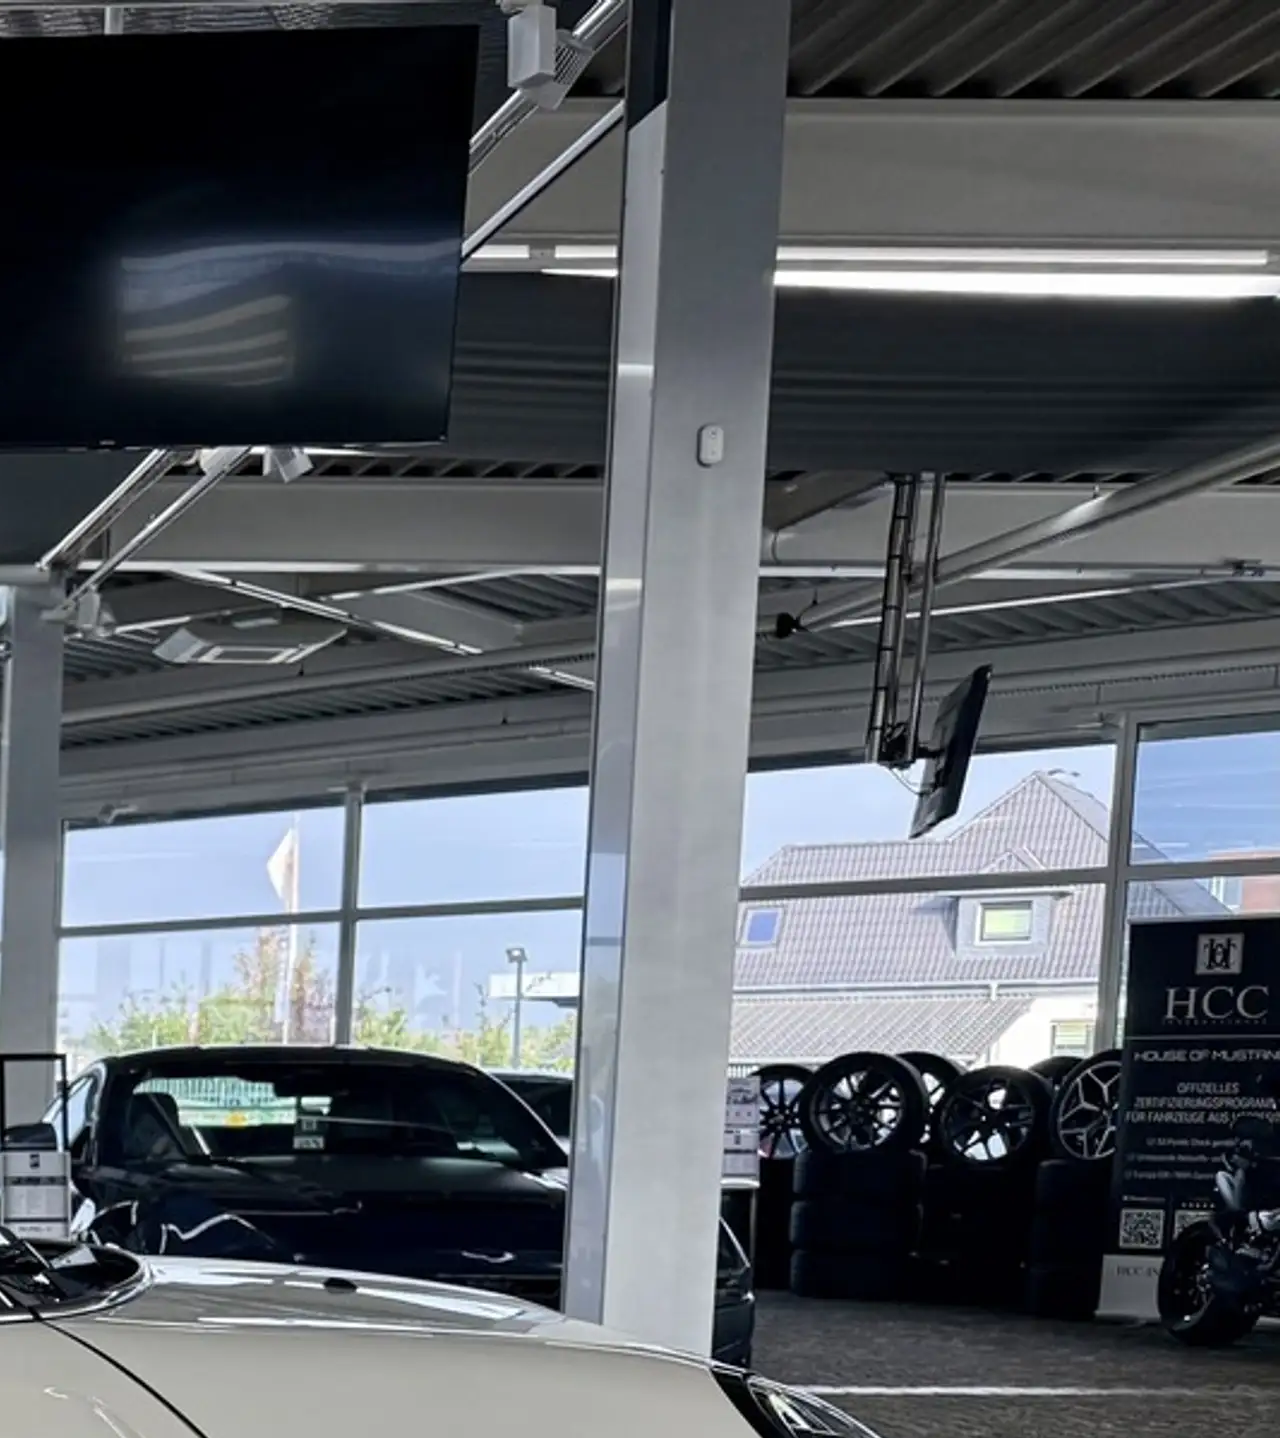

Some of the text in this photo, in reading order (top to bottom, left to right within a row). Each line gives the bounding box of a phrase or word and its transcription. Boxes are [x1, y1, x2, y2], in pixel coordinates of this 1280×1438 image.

[1165, 985, 1269, 1019] HCC
[1133, 1049, 1186, 1062] HOUSE
[1189, 1048, 1210, 1061] OF
